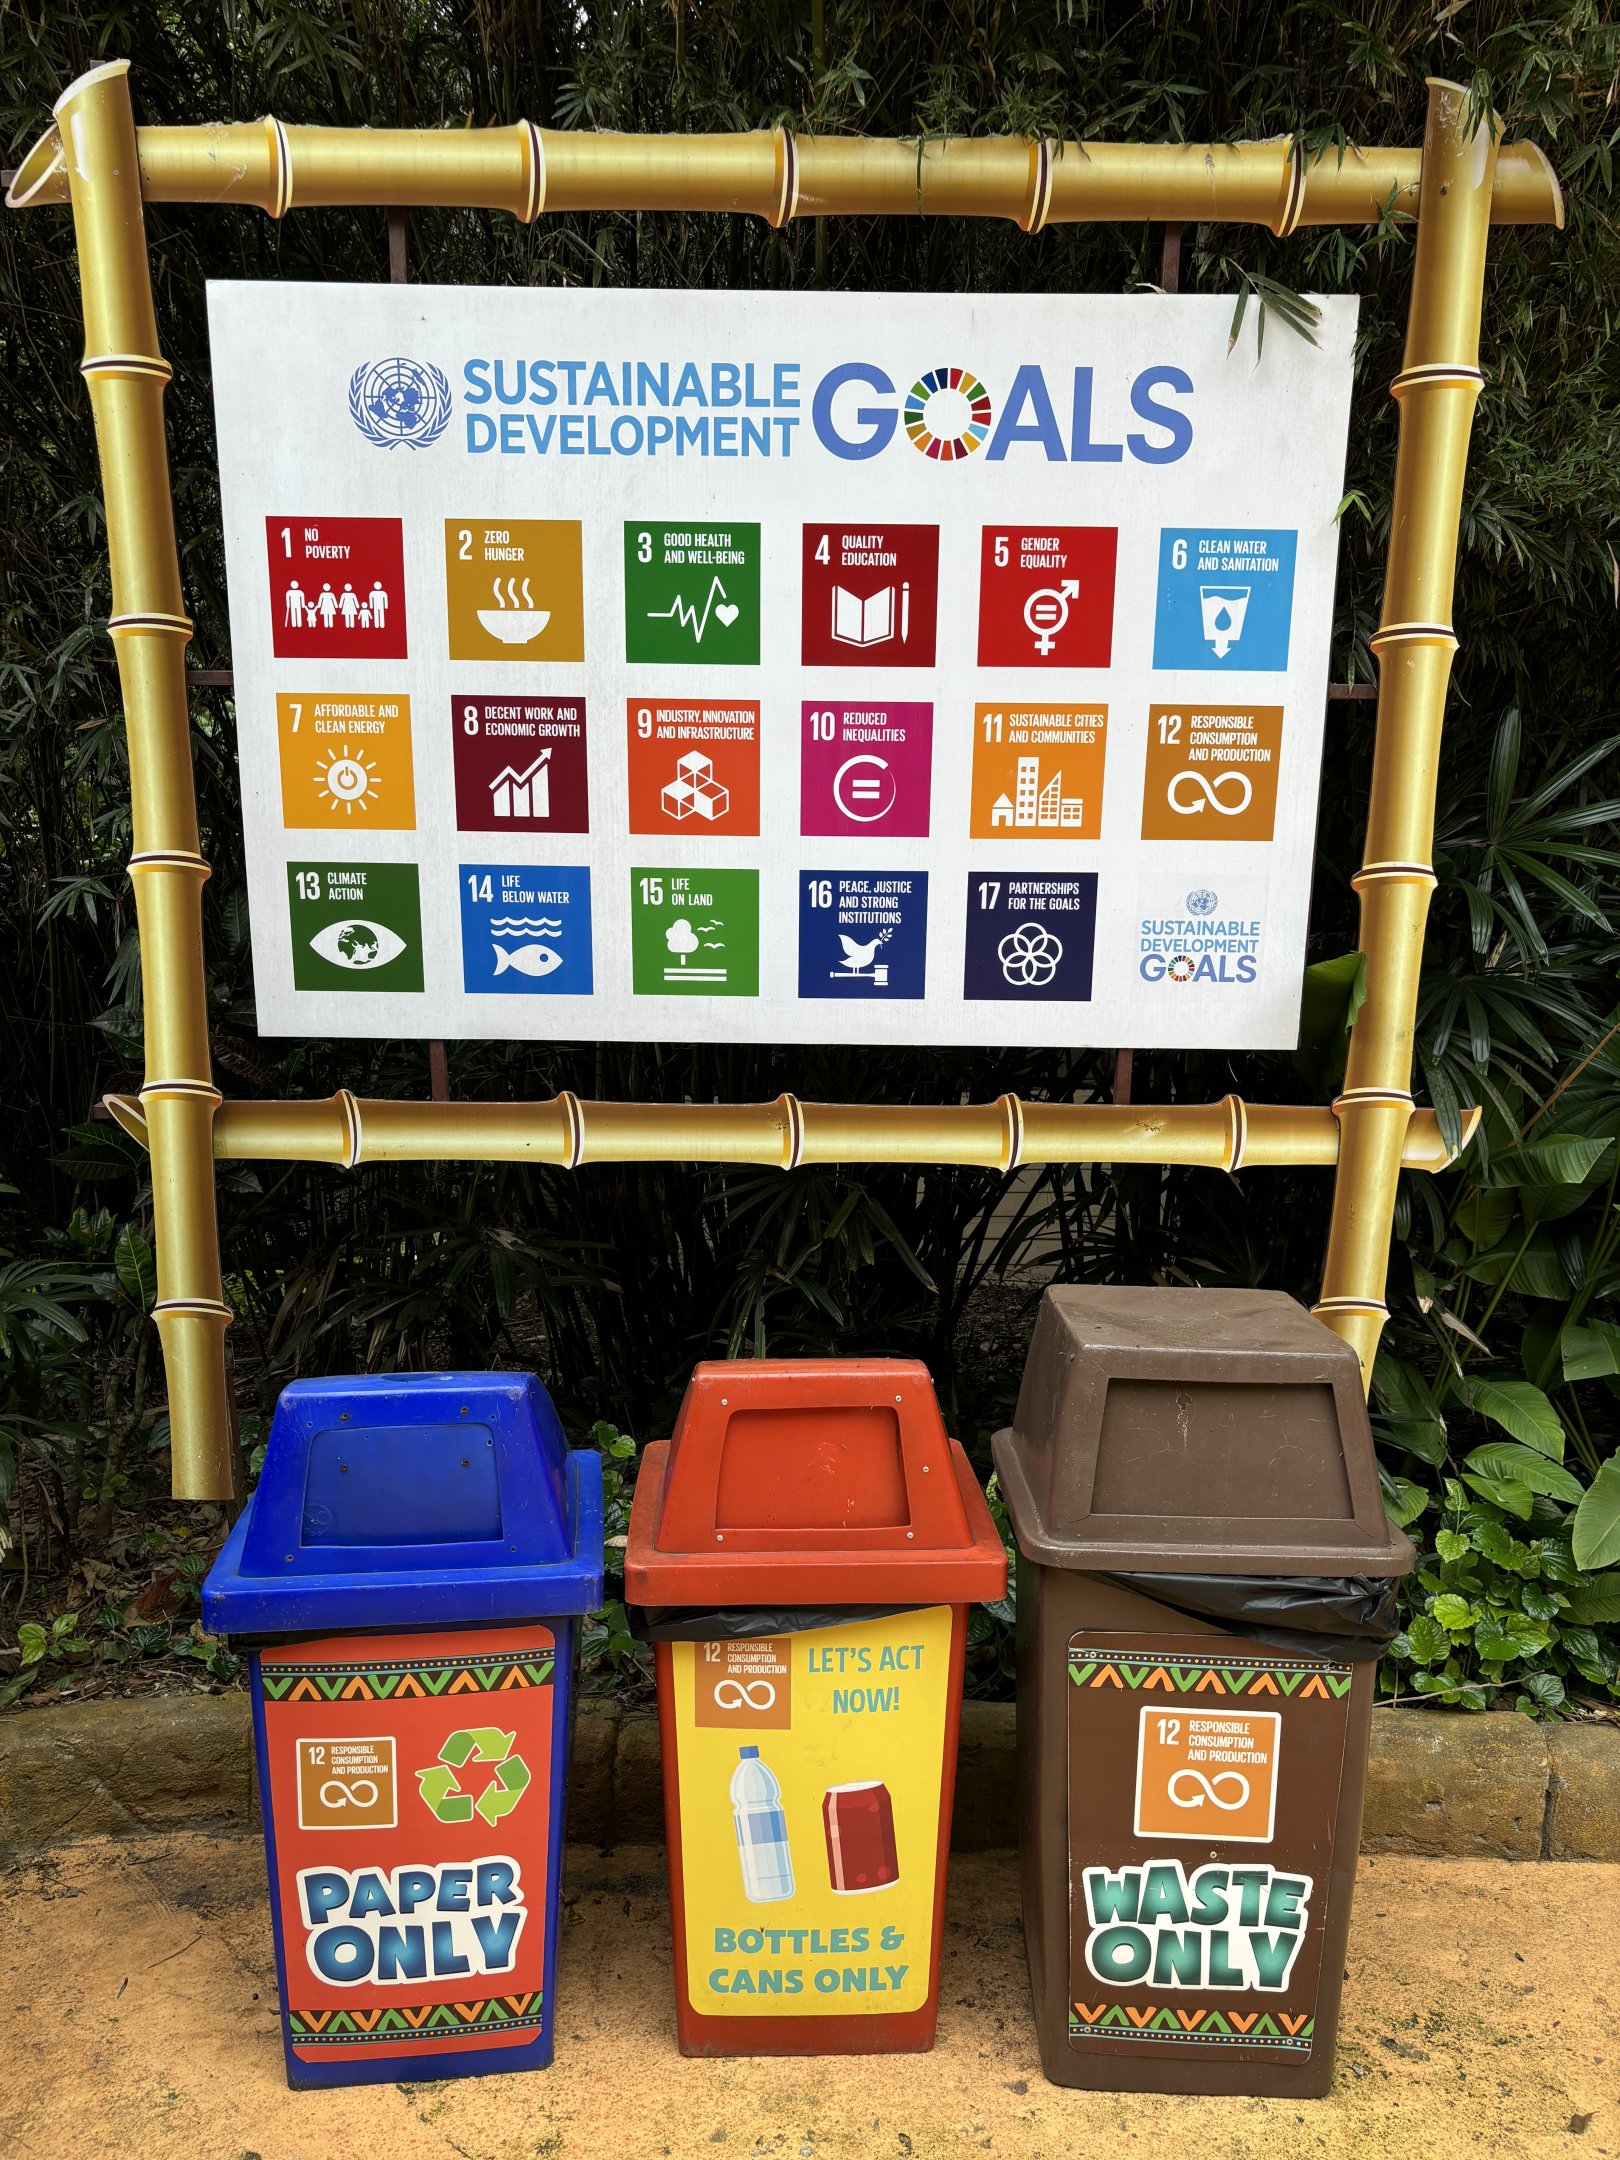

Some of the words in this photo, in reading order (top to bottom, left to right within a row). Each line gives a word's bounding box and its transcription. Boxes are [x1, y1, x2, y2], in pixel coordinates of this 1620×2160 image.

[463, 359, 801, 407] SUSTAINABLE
[812, 362, 1194, 464] GOALS
[467, 414, 799, 457] DEVELOPMENT
[305, 528, 318, 541] NO
[485, 531, 509, 544] ZERO
[664, 533, 691, 546] GOOD
[695, 534, 731, 547] HEALTH
[281, 528, 291, 557] 1
[459, 530, 472, 560] 2
[638, 532, 652, 562] 3
[842, 535, 883, 549] QUALITY
[1021, 538, 1059, 551] GENDER
[1199, 540, 1230, 553] CLEAN
[1234, 541, 1266, 554] WATER
[306, 545, 350, 558] POVERTY
[485, 548, 524, 561] HUNGER
[815, 535, 830, 564] 4
[995, 537, 1008, 567] 5
[1173, 539, 1187, 569] 6
[664, 550, 684, 563] AND
[688, 551, 744, 564] WELL-BEING
[842, 553, 896, 566] EDUCATION
[1021, 555, 1067, 569] EQUALITY
[1198, 557, 1218, 570] AND
[1222, 558, 1279, 571] SANITATION
[315, 704, 375, 717] AFFORDABLE
[379, 705, 398, 717] AND
[485, 707, 521, 719] DECENT
[525, 707, 553, 720] WORK
[557, 708, 577, 720] AND
[657, 710, 701, 723] INDUSTRY,
[703, 711, 754, 723] INNOVATION
[290, 704, 302, 732] 7
[464, 706, 478, 735] 8
[638, 709, 652, 738] 9
[844, 712, 886, 725] REDUCED
[1010, 714, 1072, 726] SUSTAINABLE
[1075, 715, 1103, 727] CITIES
[1191, 716, 1254, 729] RESPONSIBLE
[315, 720, 345, 733] CLEAN
[349, 721, 385, 733] ENERGY
[486, 723, 535, 736] ECONOMIC
[539, 724, 580, 736] GROWTH
[657, 726, 675, 738] AND
[678, 727, 754, 740] INFRASTRUCTURE
[811, 712, 835, 740] 10
[984, 714, 1002, 742] 11
[1158, 715, 1181, 744] 12
[843, 729, 905, 742] INEQUALITIES
[1009, 730, 1028, 742] AND
[1031, 731, 1095, 743] COMMUNITIES
[1190, 732, 1258, 746] CONSUMPTION
[1189, 748, 1208, 760] AND
[1211, 749, 1271, 761] PRODUCTION
[328, 872, 367, 884] CLIMATE
[502, 875, 520, 887] LIFE
[672, 878, 689, 890] LIFE
[296, 872, 320, 899] 13
[469, 875, 493, 902] 14
[640, 878, 663, 905] 15
[840, 881, 871, 893] PEACE,
[874, 881, 912, 893] JUSTICE
[1009, 882, 1079, 894] PARTNERSHIPS
[329, 888, 363, 900] ACTION
[503, 891, 534, 903] BELOW
[538, 892, 569, 903] WATER
[672, 894, 684, 905] ON
[689, 894, 712, 905] LAND
[809, 881, 832, 908] 16
[979, 882, 1000, 909] 17
[839, 896, 859, 909] AND
[861, 896, 898, 909] STRONG
[1009, 898, 1026, 909] FOR
[1029, 898, 1046, 909] THE
[1049, 898, 1080, 910] GOALS
[839, 912, 901, 923] INSTITUTIONS
[1141, 920, 1260, 936] SUSTAINABLE
[1140, 939, 1259, 952] DEVELOPMENT
[1140, 954, 1256, 983] GOALS
[704, 1643, 720, 1662] 12
[727, 1643, 773, 1653] RESPONSIBLE
[727, 1654, 777, 1664] CONSUMPTION
[808, 1648, 872, 1673] LET'S
[879, 1645, 924, 1671] ACT
[728, 1665, 742, 1673] AND
[744, 1665, 786, 1673] PRODUCTION
[833, 1687, 899, 1714] NOW!
[1158, 1719, 1180, 1745] 12
[1189, 1720, 1250, 1734] RESPONSIBLE
[1188, 1735, 1254, 1749] CONSUMPTION
[309, 1747, 325, 1765] 12
[331, 1745, 375, 1755] RESPONSIBLE
[1188, 1749, 1207, 1761] AND
[1209, 1750, 1267, 1763] PRODUCTION
[331, 1755, 378, 1765] CONSUMPTION
[347, 1765, 388, 1774] PRODUCTION
[303, 1862, 517, 1925] PAPER
[1090, 1865, 1307, 1930] WASTE
[313, 1912, 520, 1981] ONLY
[714, 1928, 869, 1954] BOTTLES
[880, 1926, 904, 1951] &
[1092, 1925, 1298, 1988] ONLY
[708, 1969, 803, 1994] CANS
[814, 1965, 909, 1993] ONLY
